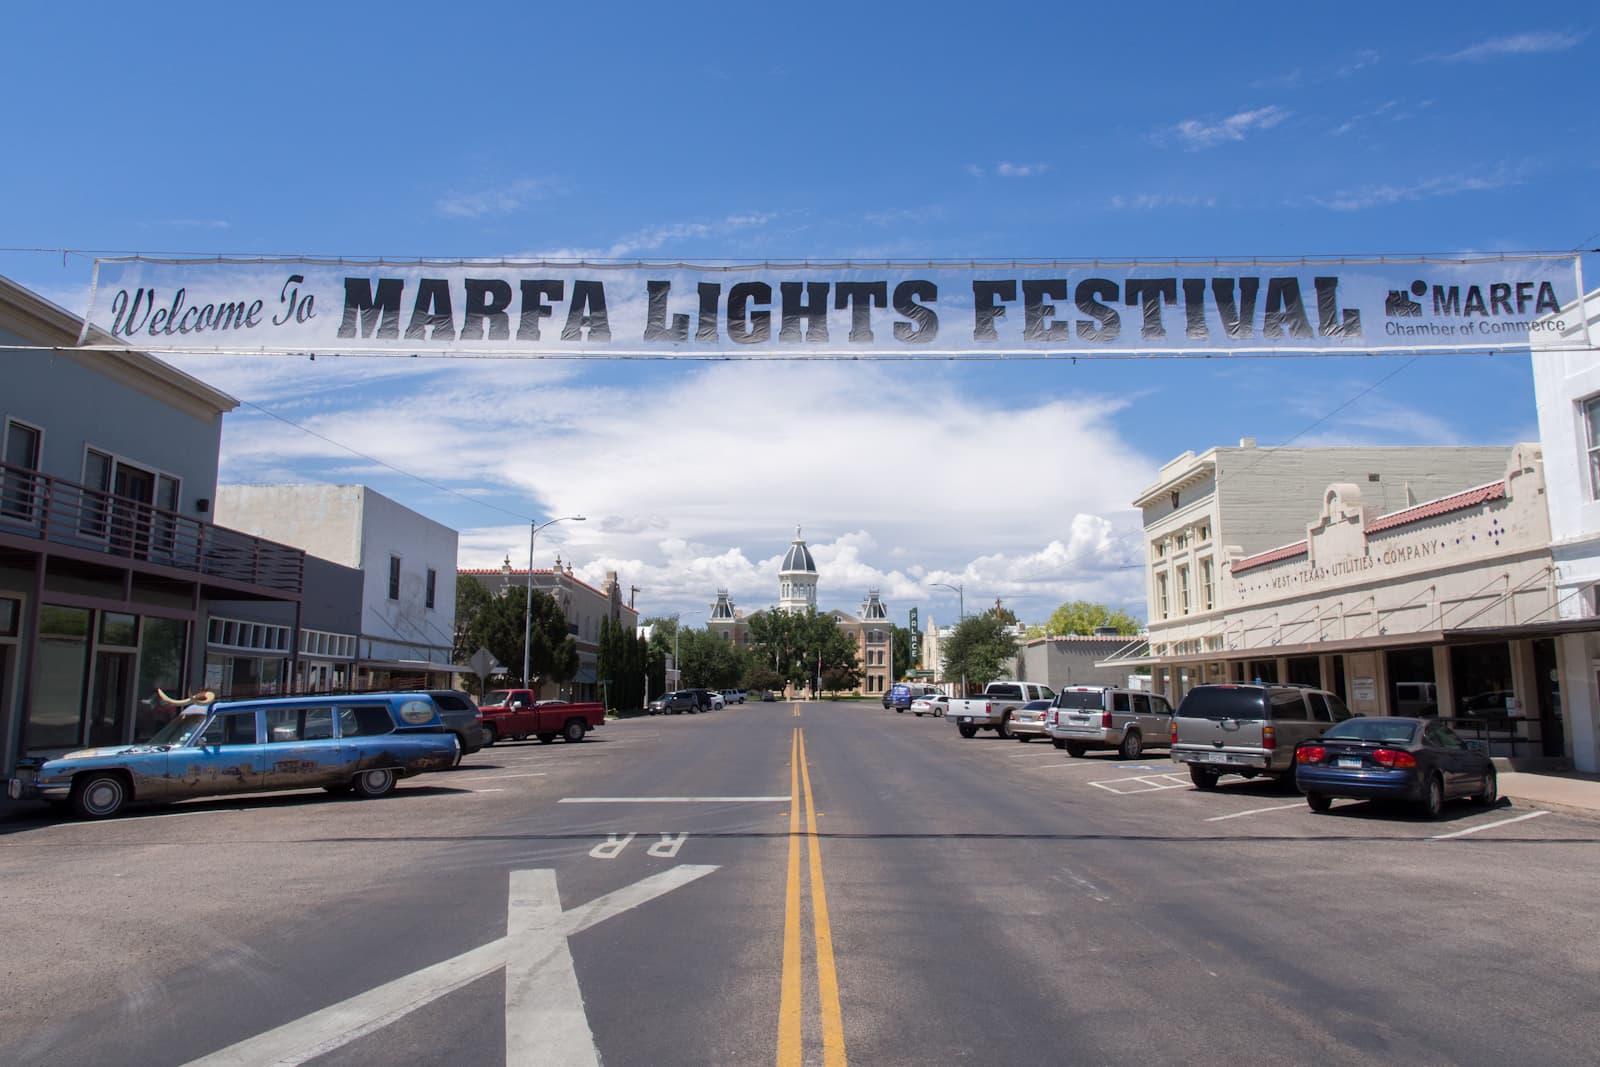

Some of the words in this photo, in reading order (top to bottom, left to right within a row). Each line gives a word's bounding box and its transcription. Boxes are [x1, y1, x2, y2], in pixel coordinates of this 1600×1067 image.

[111, 287, 263, 337] Welcome
[272, 274, 318, 325] To
[336, 276, 613, 342] MARFA
[642, 279, 939, 345] LIGHTS
[972, 277, 1361, 344] FESTIVAL
[1432, 281, 1562, 318] MARFA
[1385, 320, 1456, 337] Chamber
[1461, 321, 1476, 335] of
[1479, 319, 1567, 335] Commerce
[1271, 575, 1291, 589] WEST
[1298, 566, 1326, 584] TEXAS
[1331, 555, 1375, 577] UTILITIES
[1382, 540, 1439, 565] COMPANY
